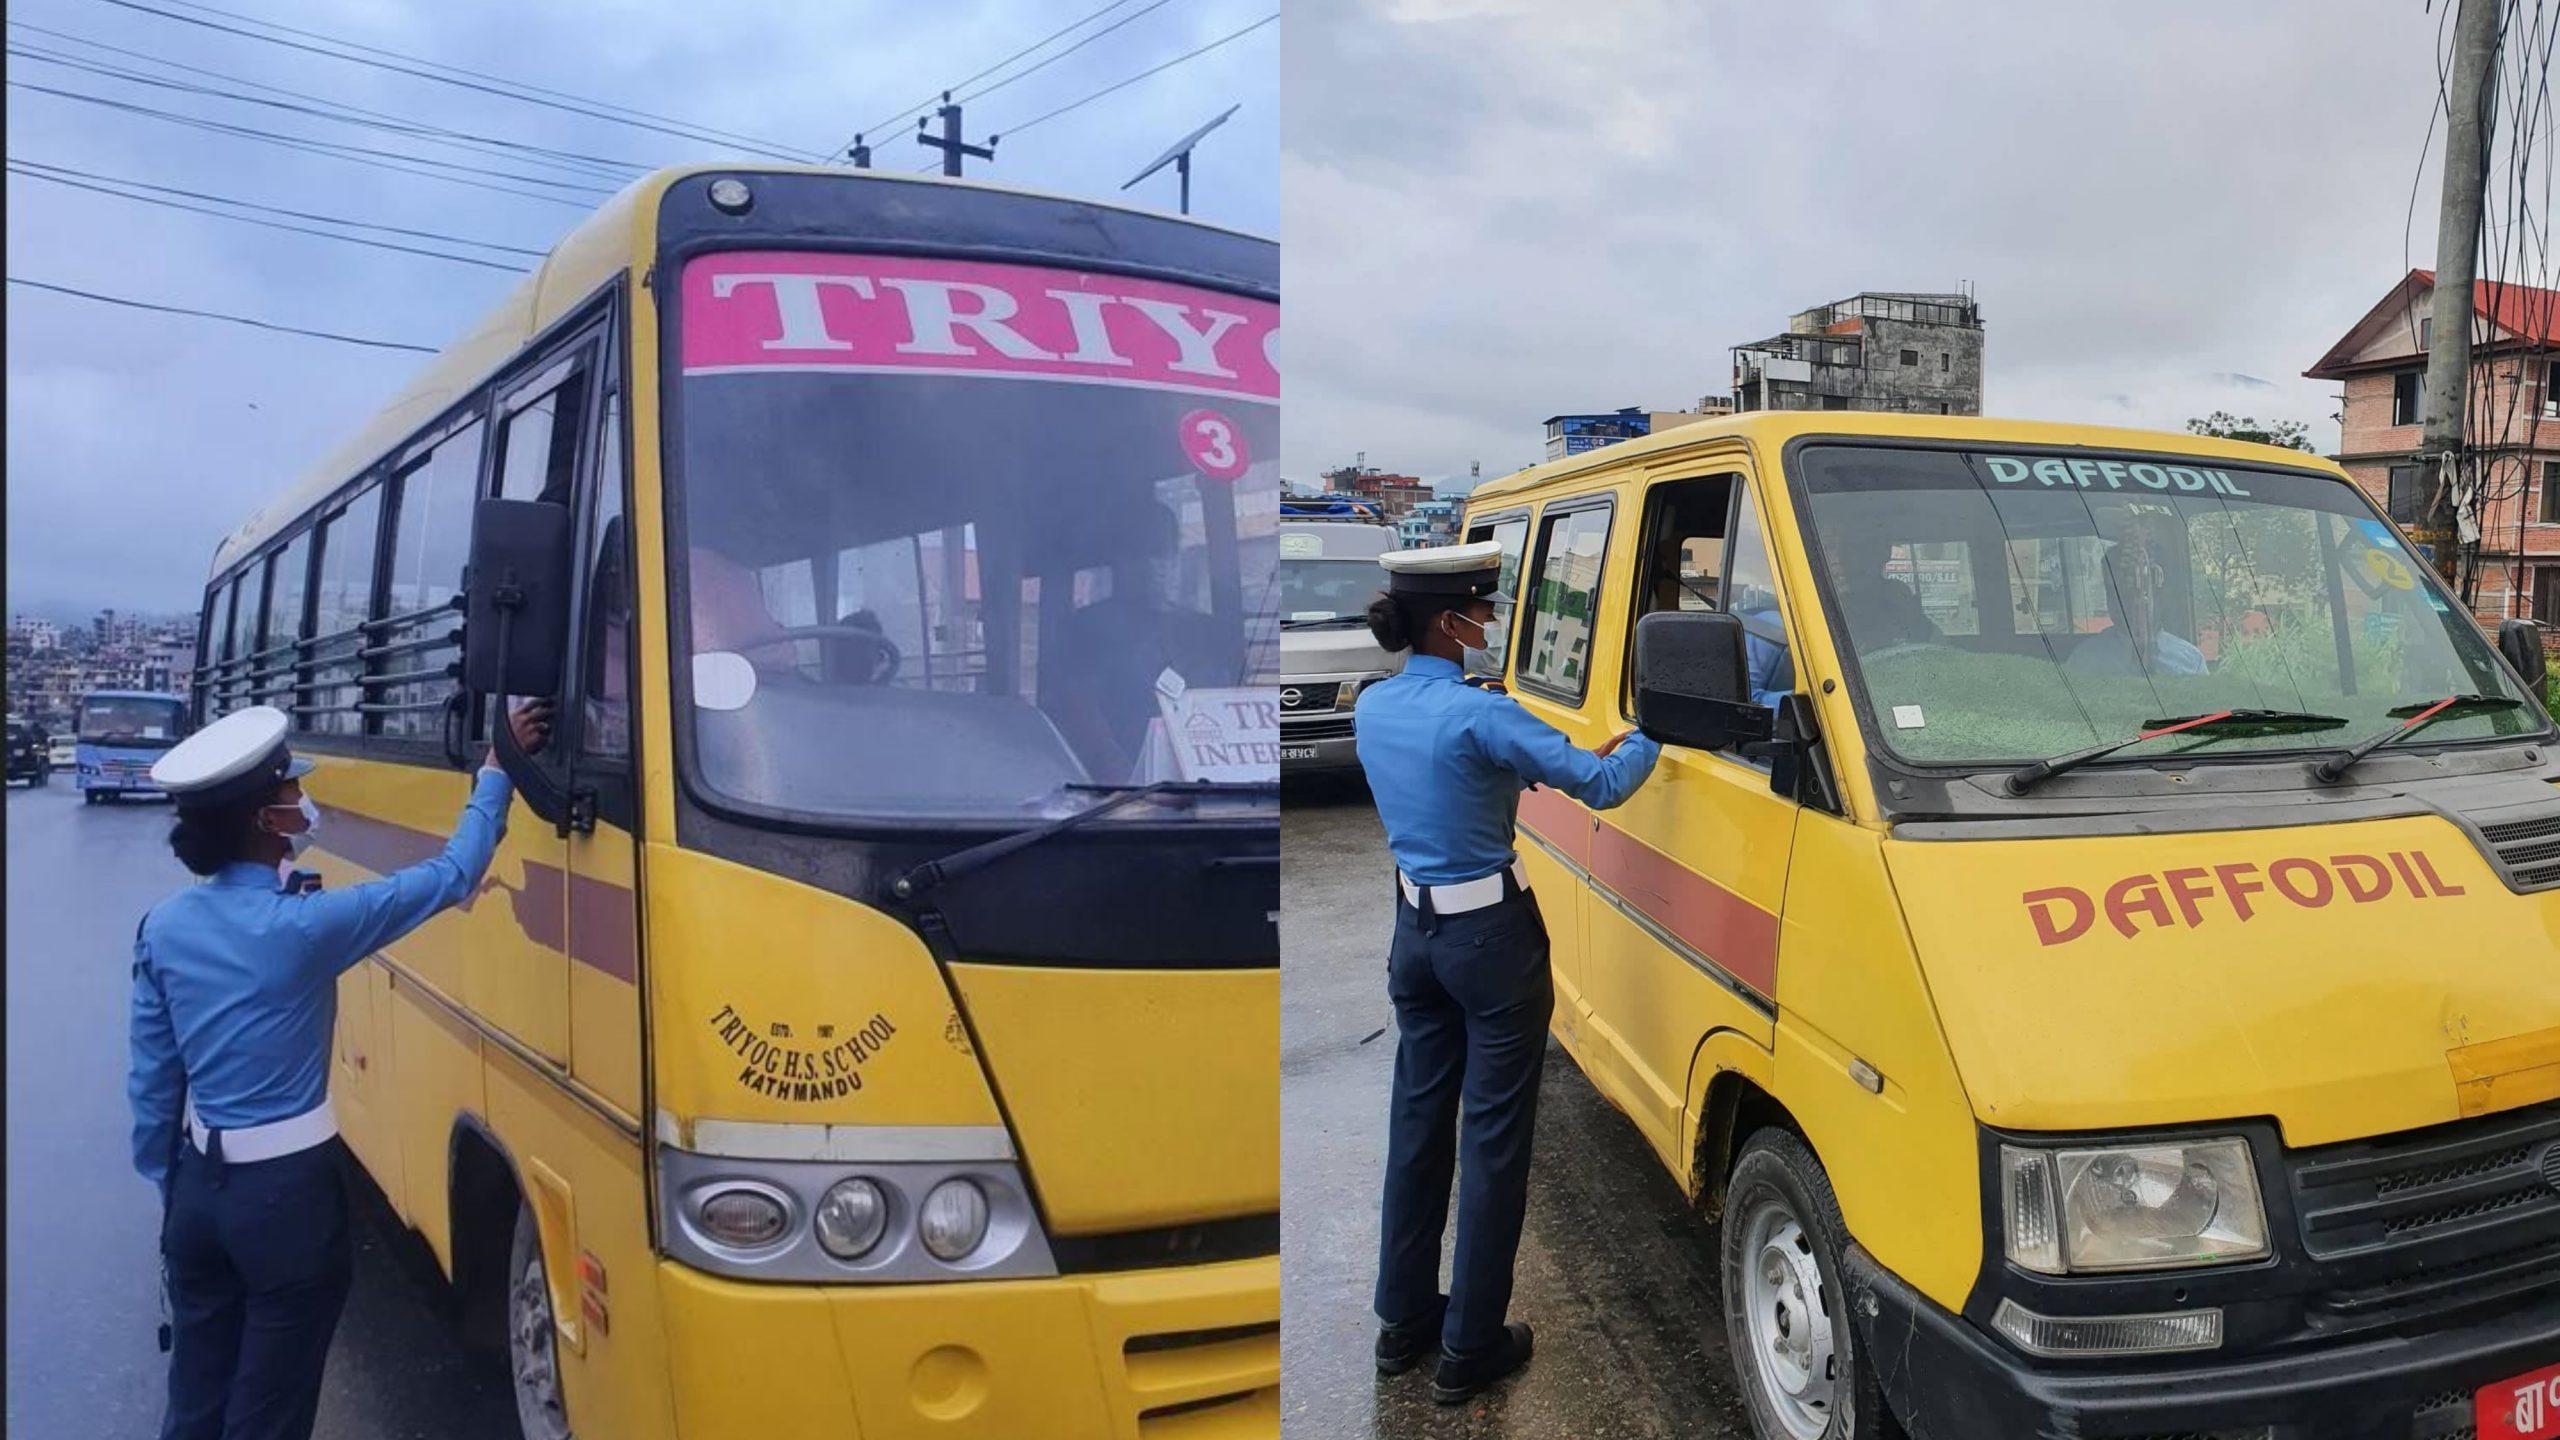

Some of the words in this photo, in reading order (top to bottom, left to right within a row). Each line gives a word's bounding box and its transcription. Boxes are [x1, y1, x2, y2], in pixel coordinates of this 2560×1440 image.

[713, 273, 1280, 379] TRIY
[1196, 420, 1238, 467] 3
[1985, 458, 2250, 496] DAFFODIL
[1225, 702, 1280, 730] TR
[2022, 850, 2466, 947] DAFFODIL
[710, 1004, 781, 1074] TRIYOG
[823, 1013, 897, 1078] SCHOOL
[738, 1066, 862, 1102] KATHMANDU
[2514, 1380, 2546, 1434] बा
